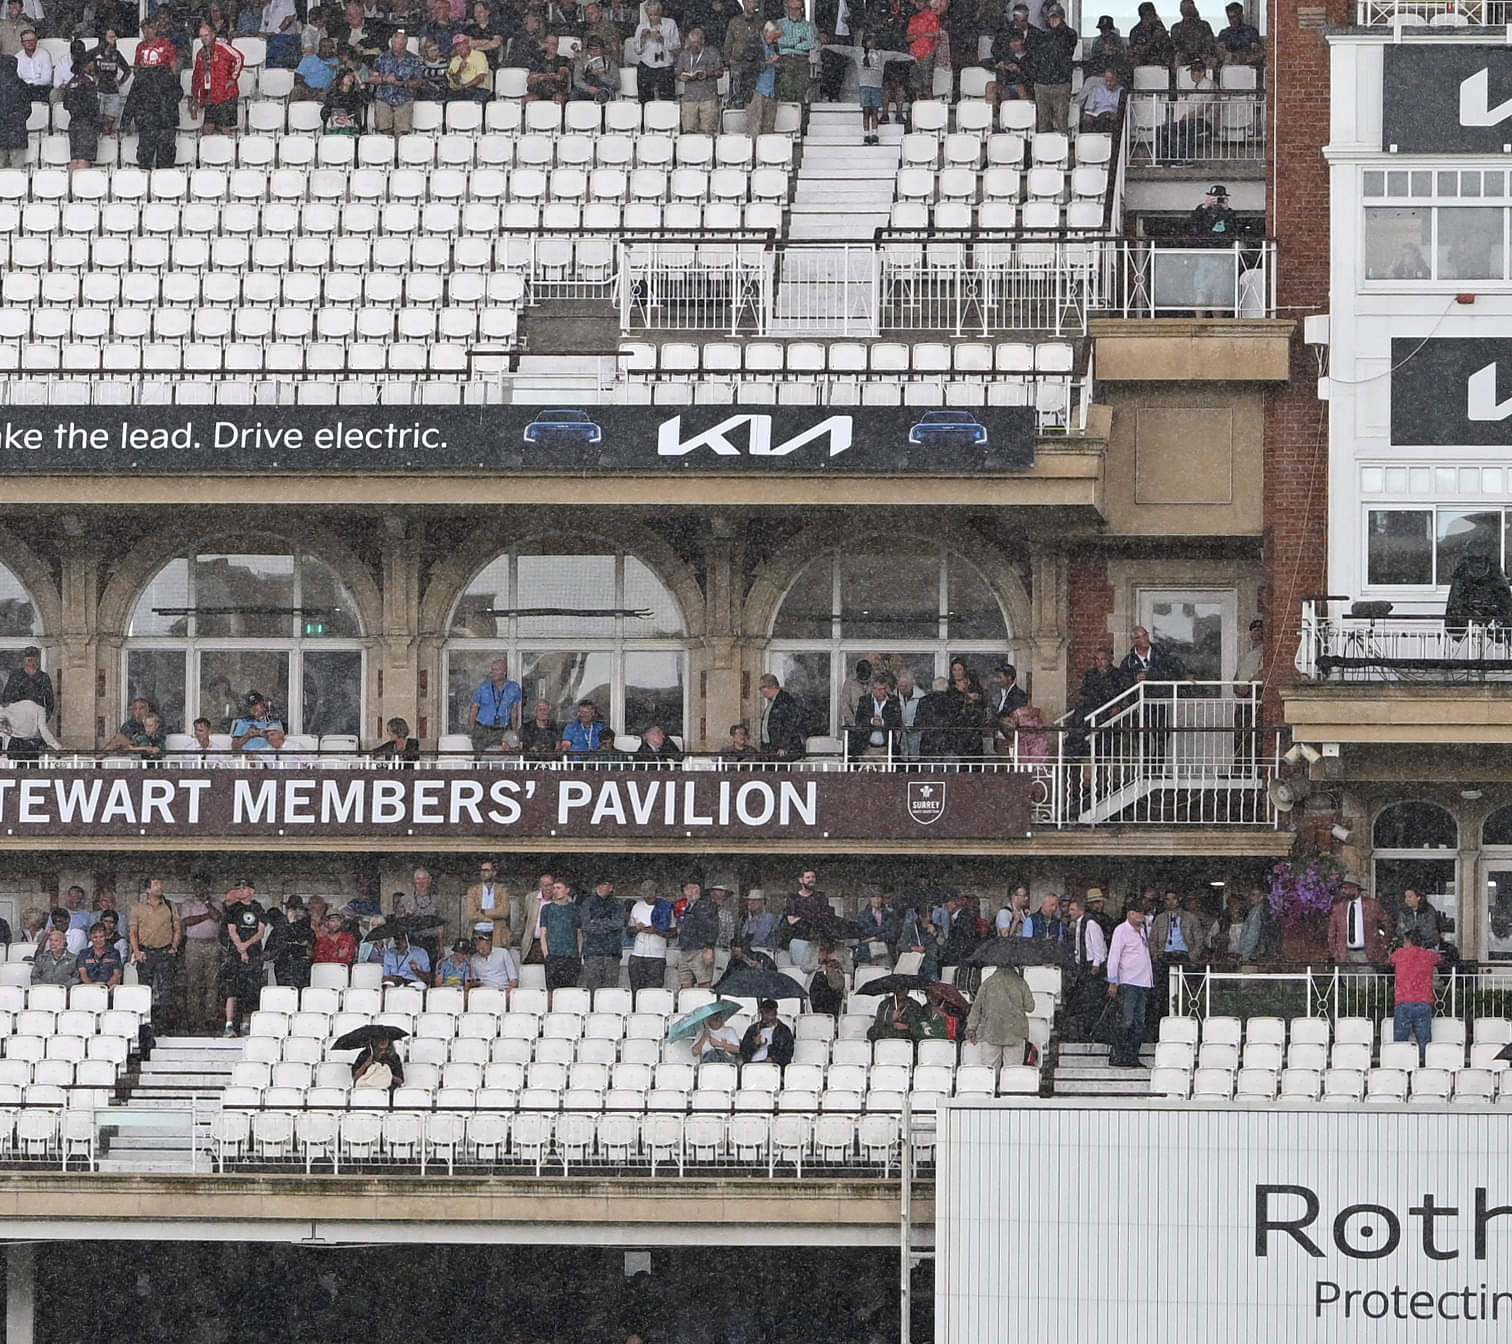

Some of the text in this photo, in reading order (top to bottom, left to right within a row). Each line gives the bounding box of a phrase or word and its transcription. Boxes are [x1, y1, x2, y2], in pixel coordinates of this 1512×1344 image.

[54, 423, 109, 450] the
[121, 422, 201, 450] lead.
[213, 422, 303, 450] Drive
[314, 422, 448, 450] electric.
[558, 779, 816, 825] PAVILION
